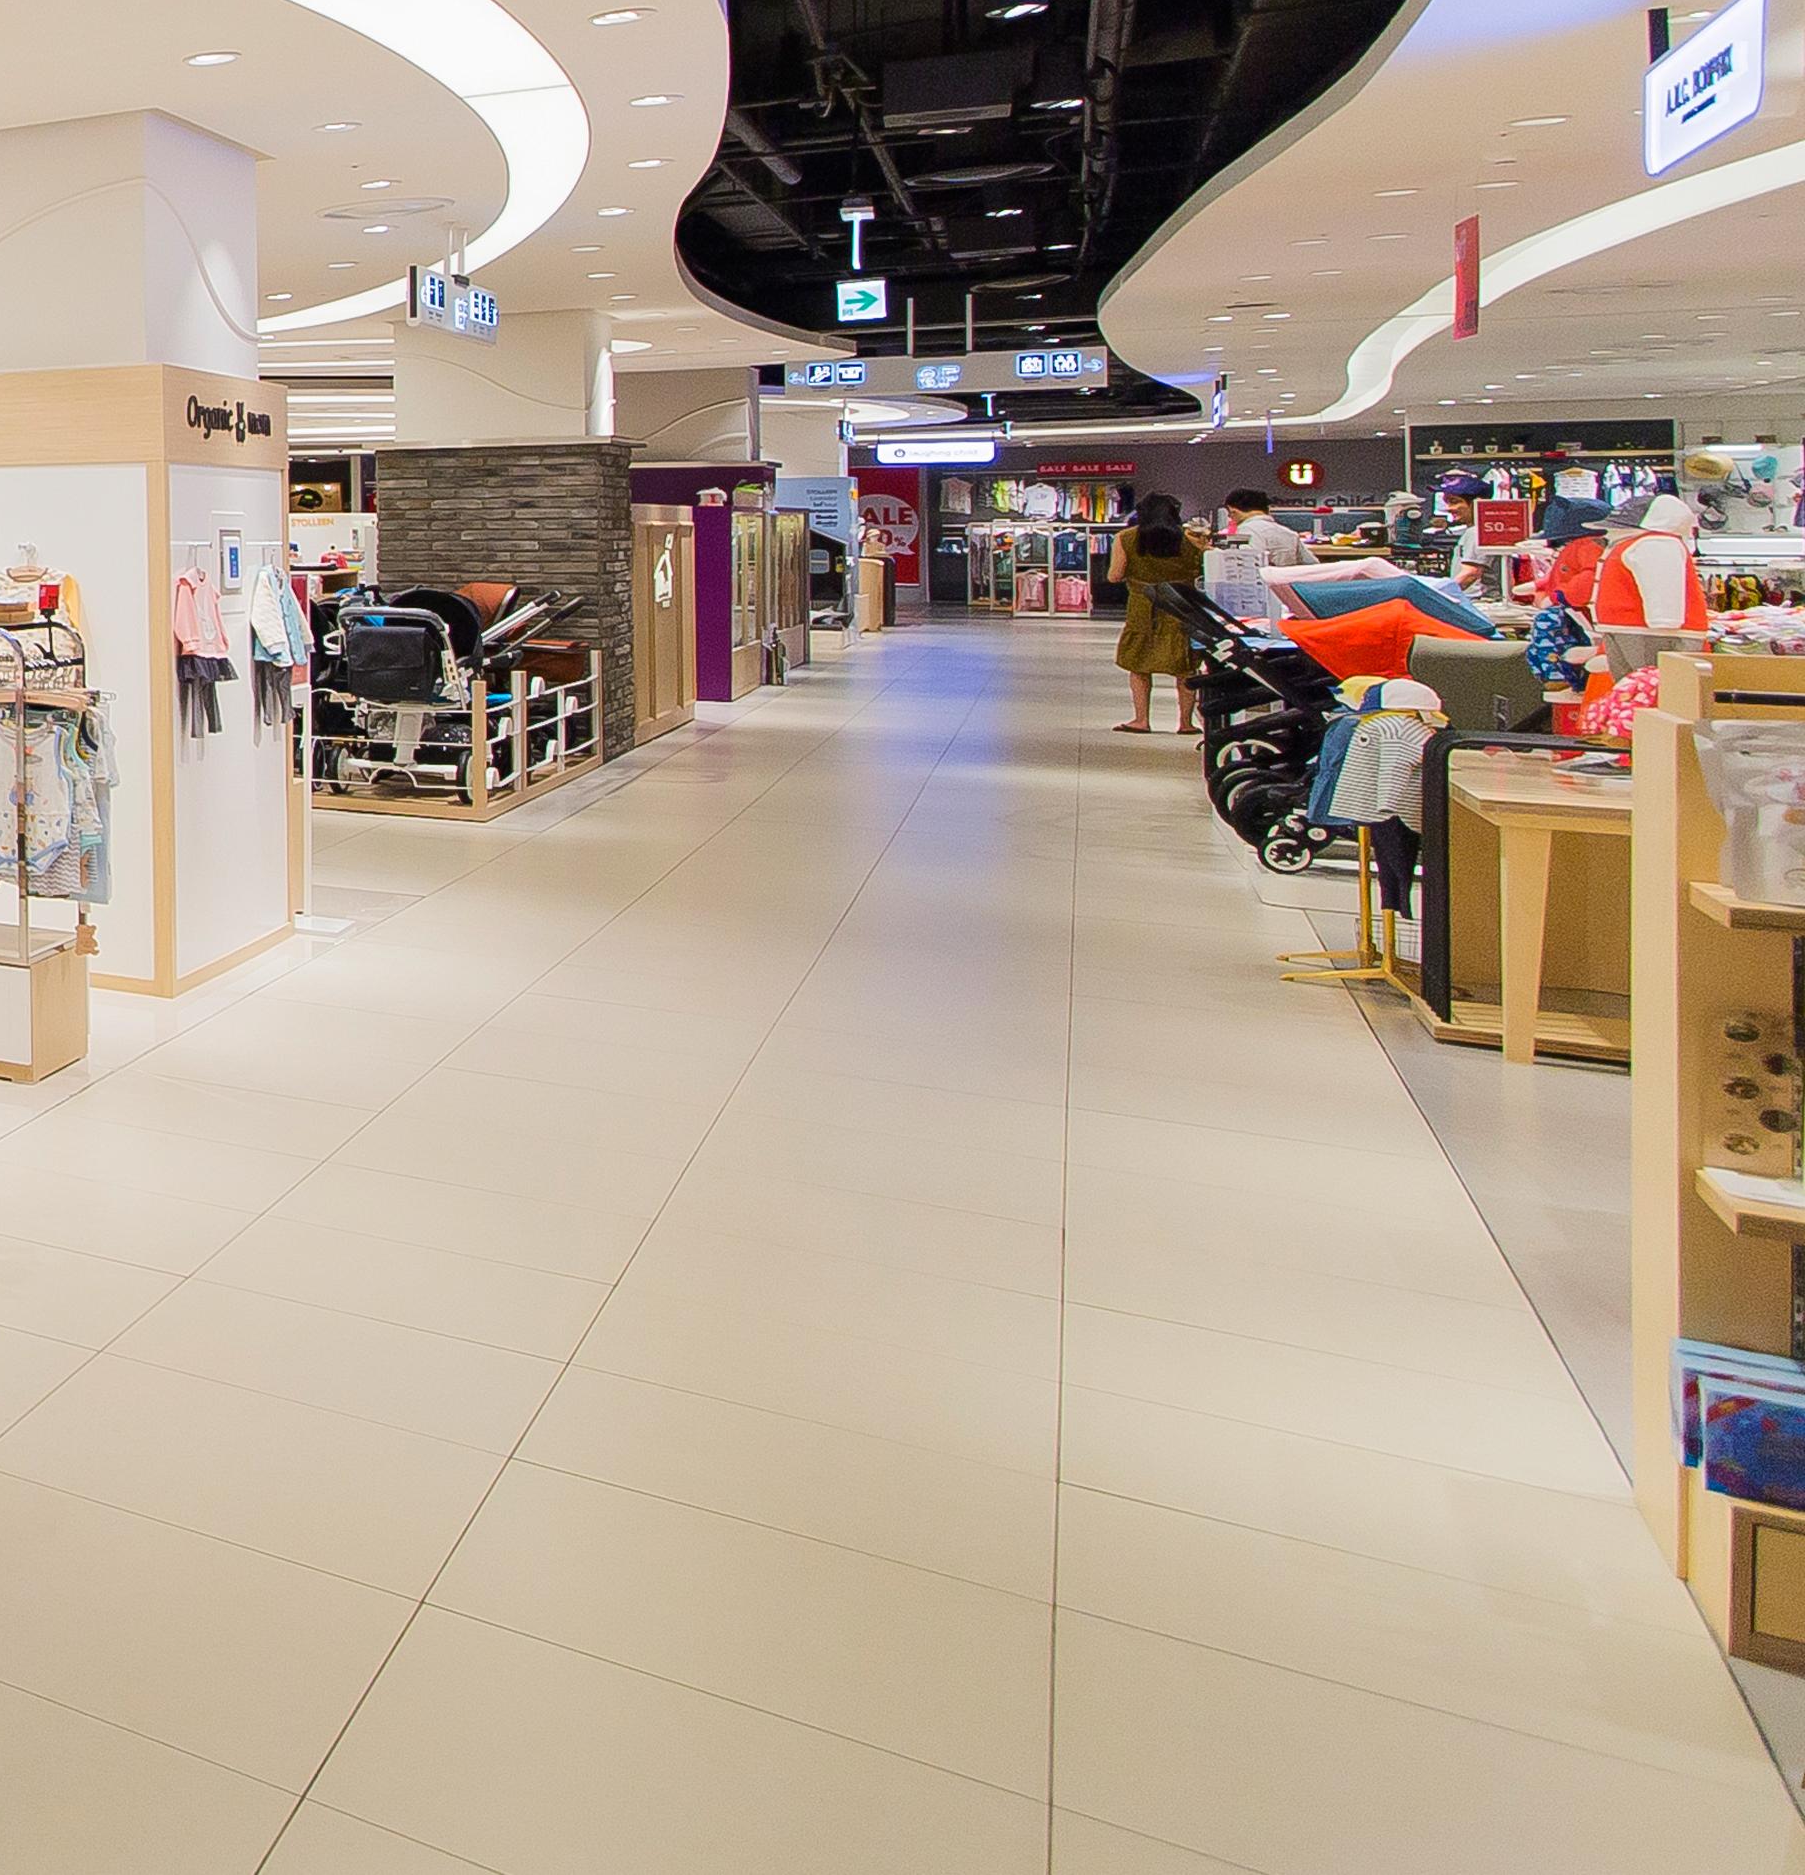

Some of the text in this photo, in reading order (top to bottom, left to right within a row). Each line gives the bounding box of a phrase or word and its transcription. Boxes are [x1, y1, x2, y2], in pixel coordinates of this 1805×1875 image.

[187, 395, 234, 439] Organic
[1040, 463, 1134, 473] SALE SALE SALE
[864, 506, 913, 525] ALE
